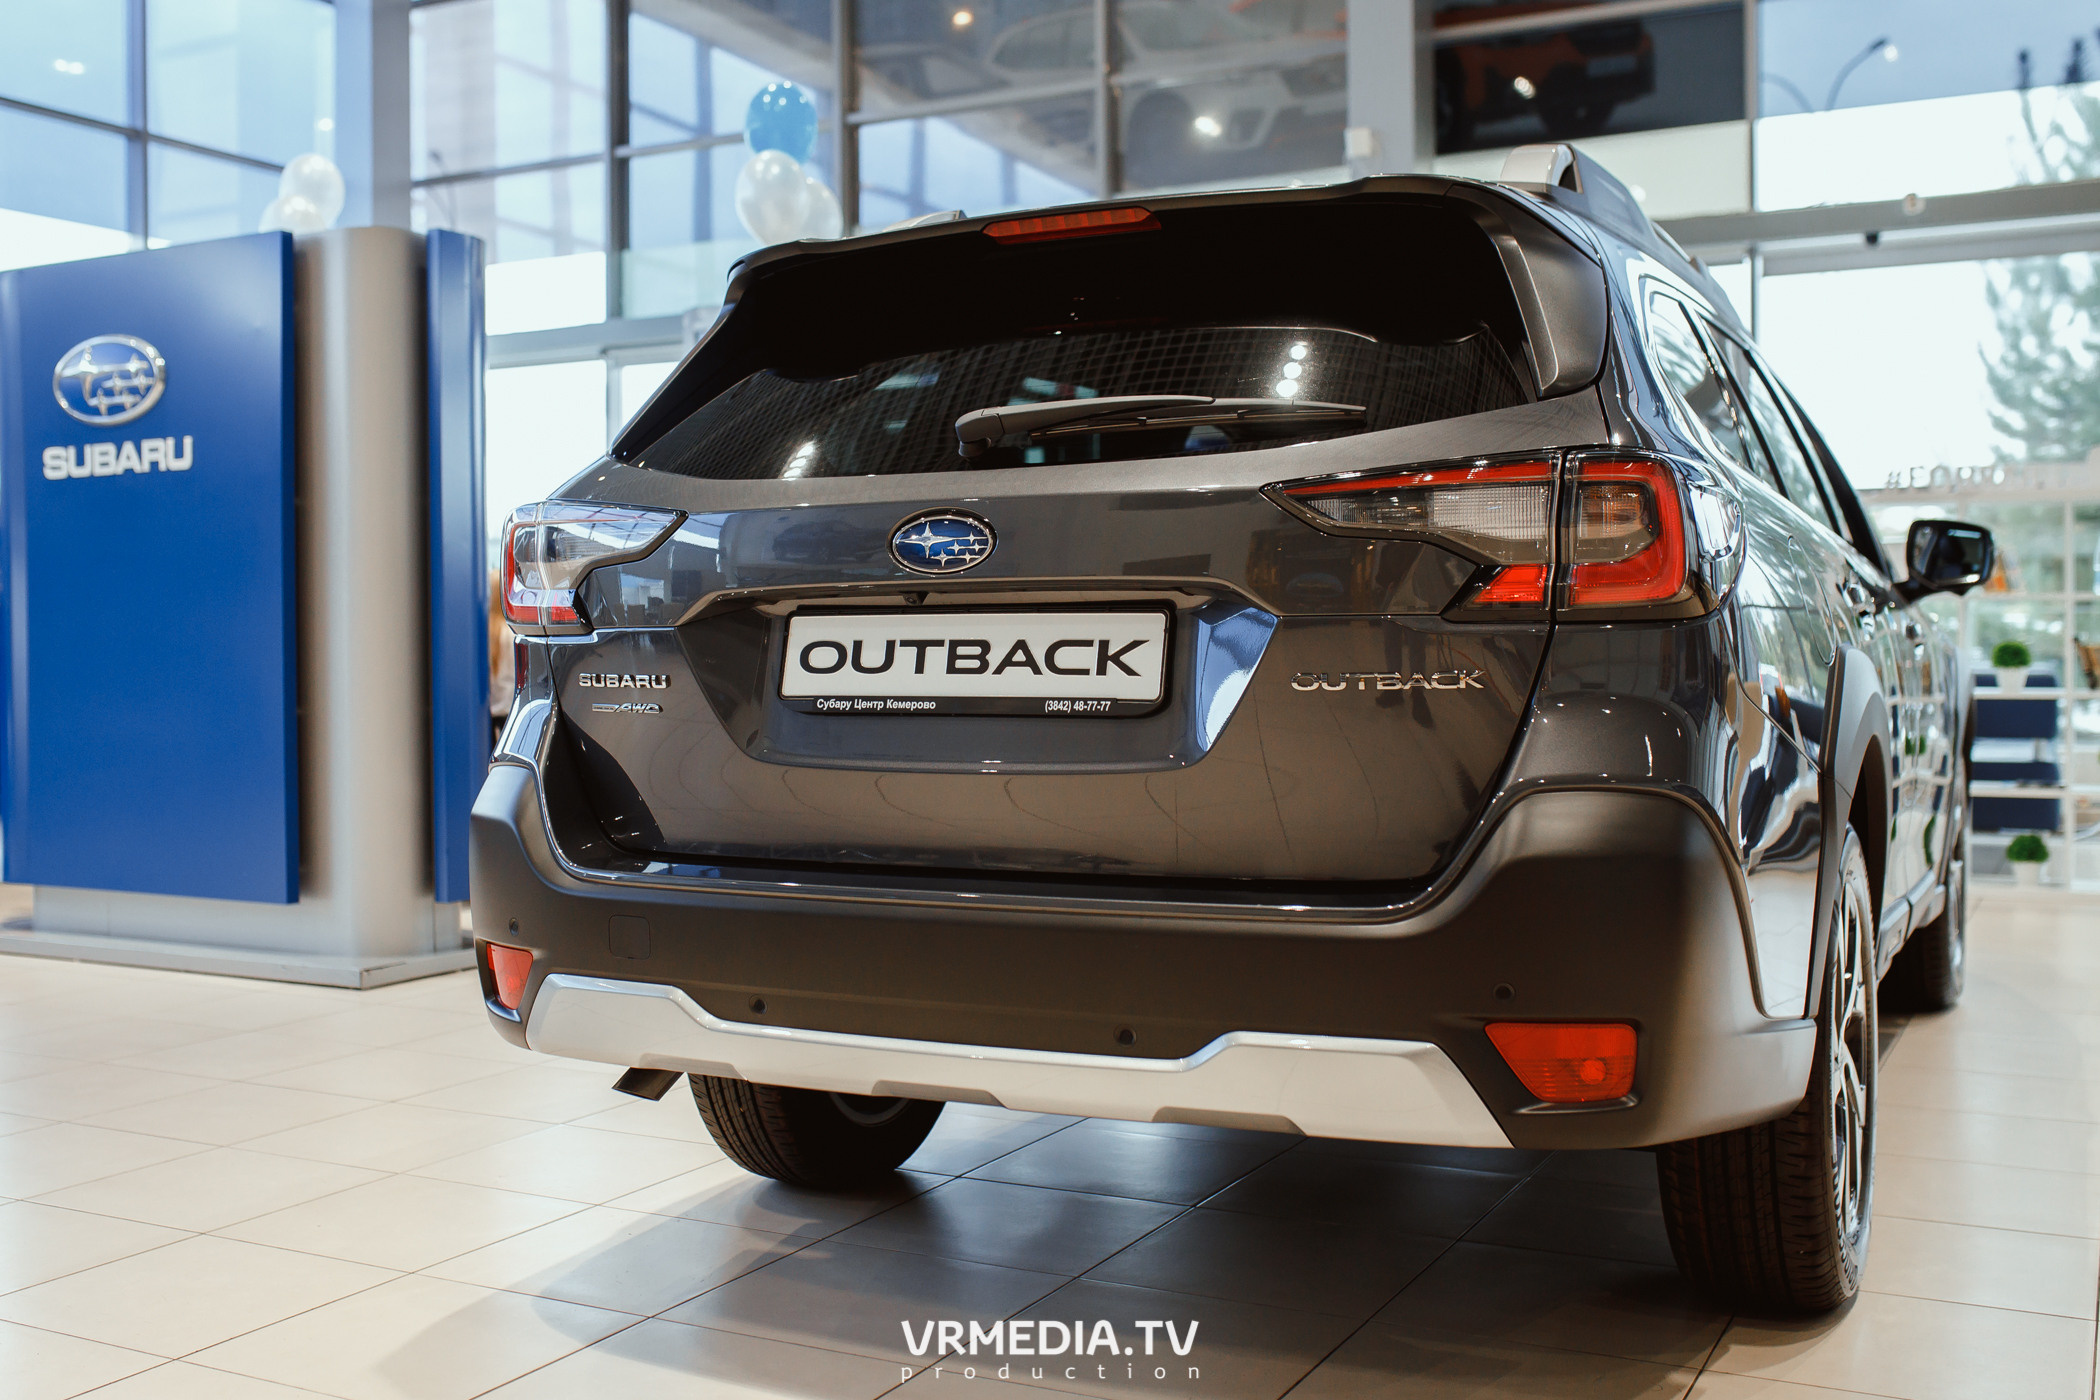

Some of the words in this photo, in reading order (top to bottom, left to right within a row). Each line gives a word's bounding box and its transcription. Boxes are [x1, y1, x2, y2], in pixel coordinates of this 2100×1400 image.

[43, 435, 193, 480] SUBARU
[799, 638, 1151, 677] OUTBACK
[578, 672, 669, 689] SUBARU
[1290, 669, 1487, 692] OUTBACK
[615, 702, 661, 714] AWD
[816, 698, 852, 711] Субару
[854, 698, 884, 711] Центр
[886, 698, 937, 711] Кемерово
[1045, 700, 1072, 713] (3842)
[1073, 700, 1111, 712] 48-77-77
